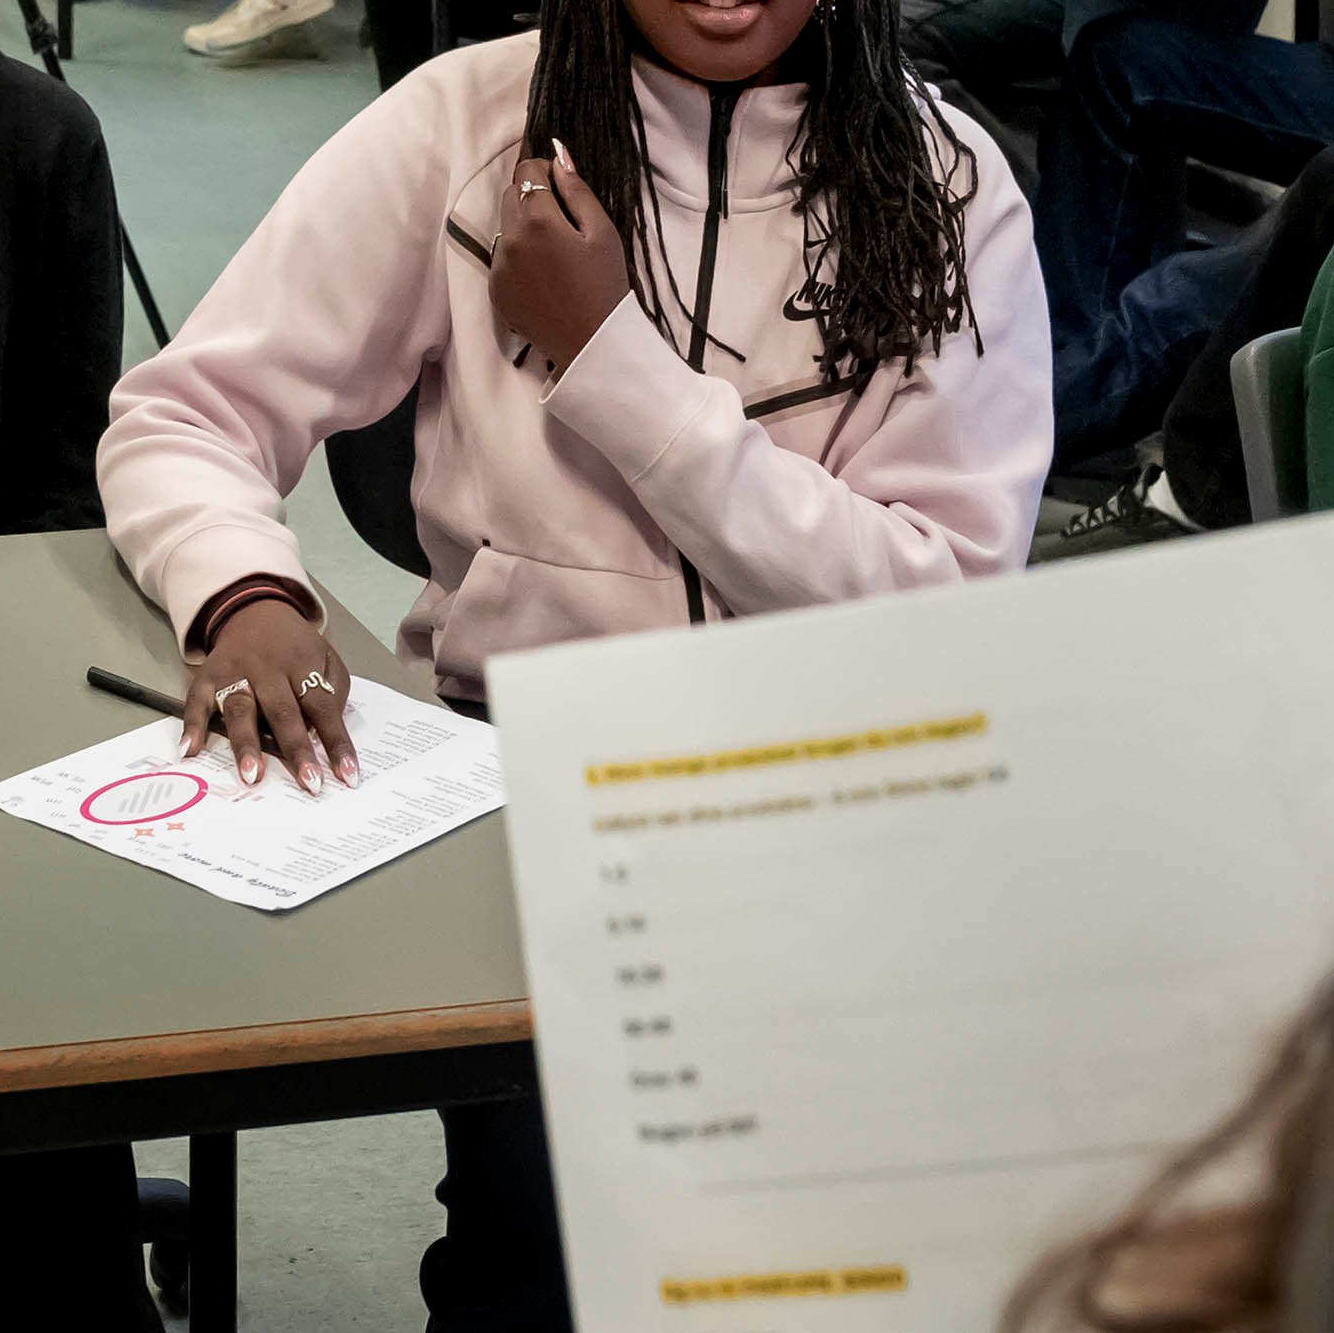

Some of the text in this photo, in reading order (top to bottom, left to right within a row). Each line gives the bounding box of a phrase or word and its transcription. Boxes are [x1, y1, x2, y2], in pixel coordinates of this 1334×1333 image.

[177, 853, 297, 897] Beauty and more
